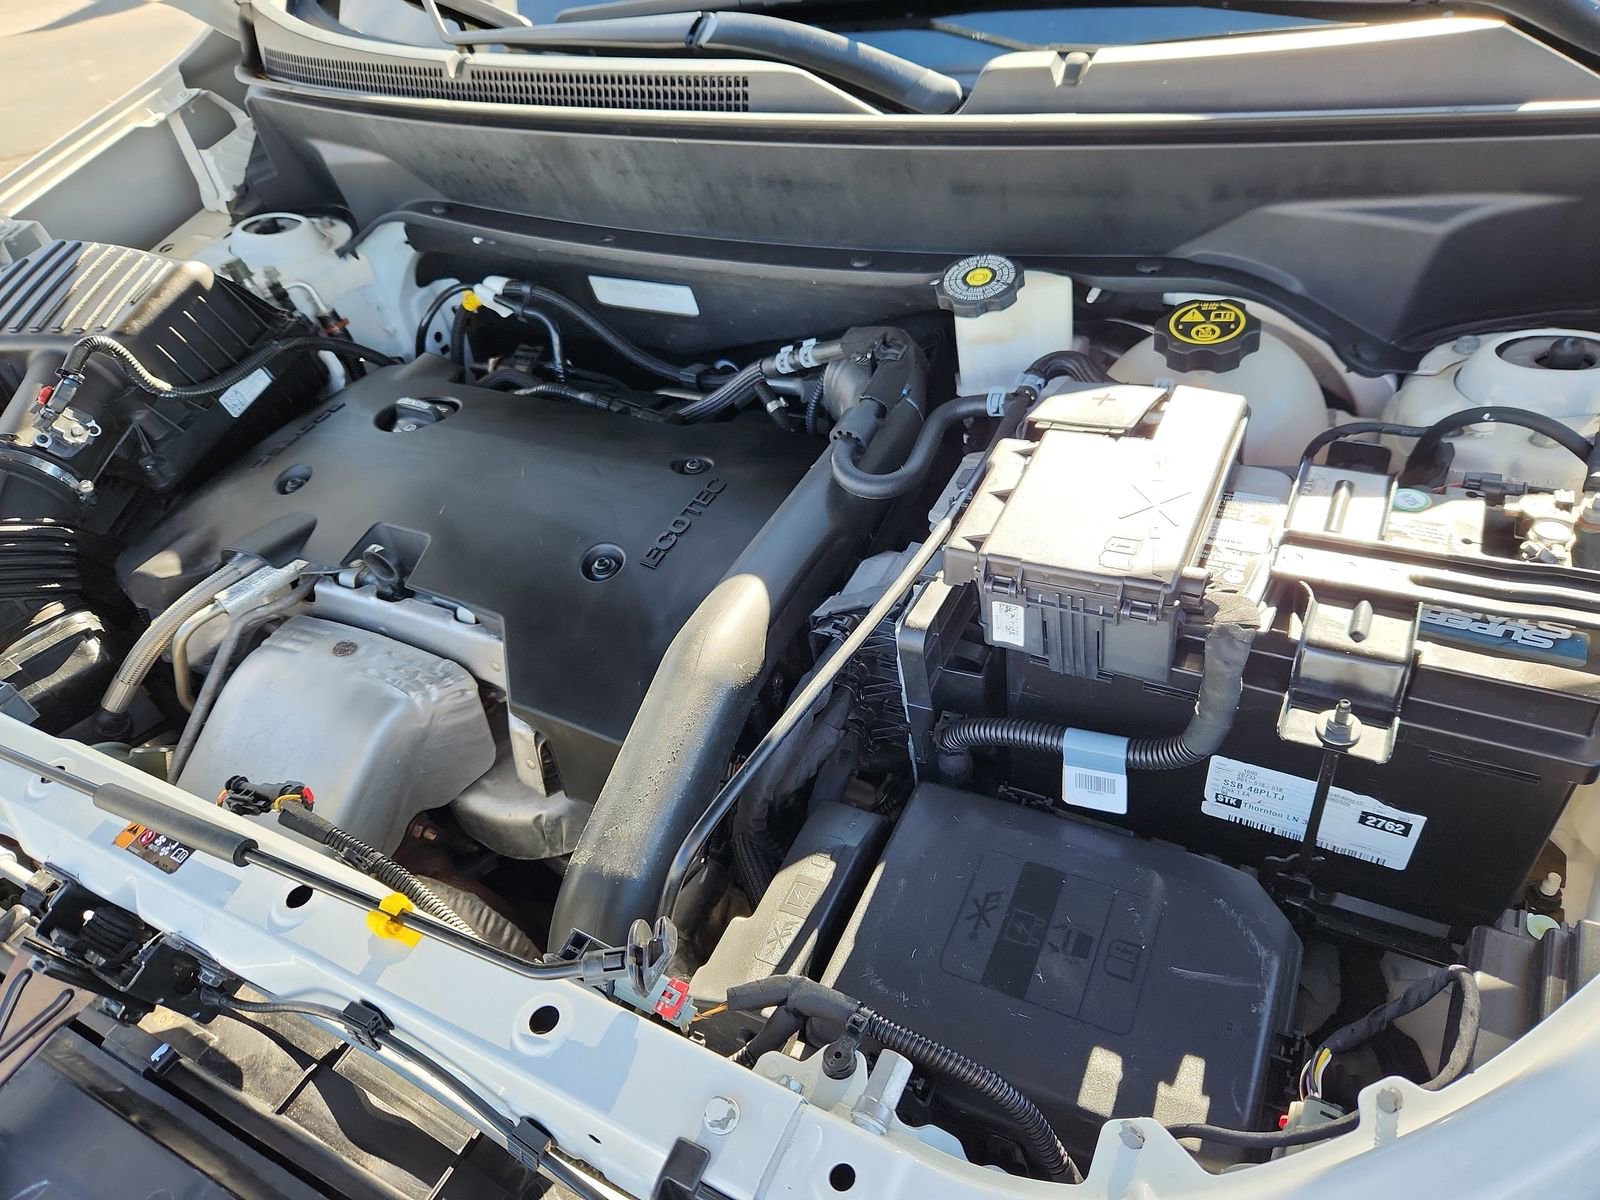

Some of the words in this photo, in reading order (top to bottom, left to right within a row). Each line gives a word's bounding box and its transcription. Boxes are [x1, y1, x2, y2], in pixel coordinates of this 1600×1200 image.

[640, 478, 727, 570] ECOTEC
[1420, 608, 1554, 649] SUPER
[1223, 779, 1243, 790] SSB
[1247, 786, 1286, 801] 48PLTJ
[1217, 794, 1237, 806] STK
[1243, 802, 1283, 818] Thornton
[1286, 815, 1299, 823] LN
[1365, 815, 1406, 835] 2762
